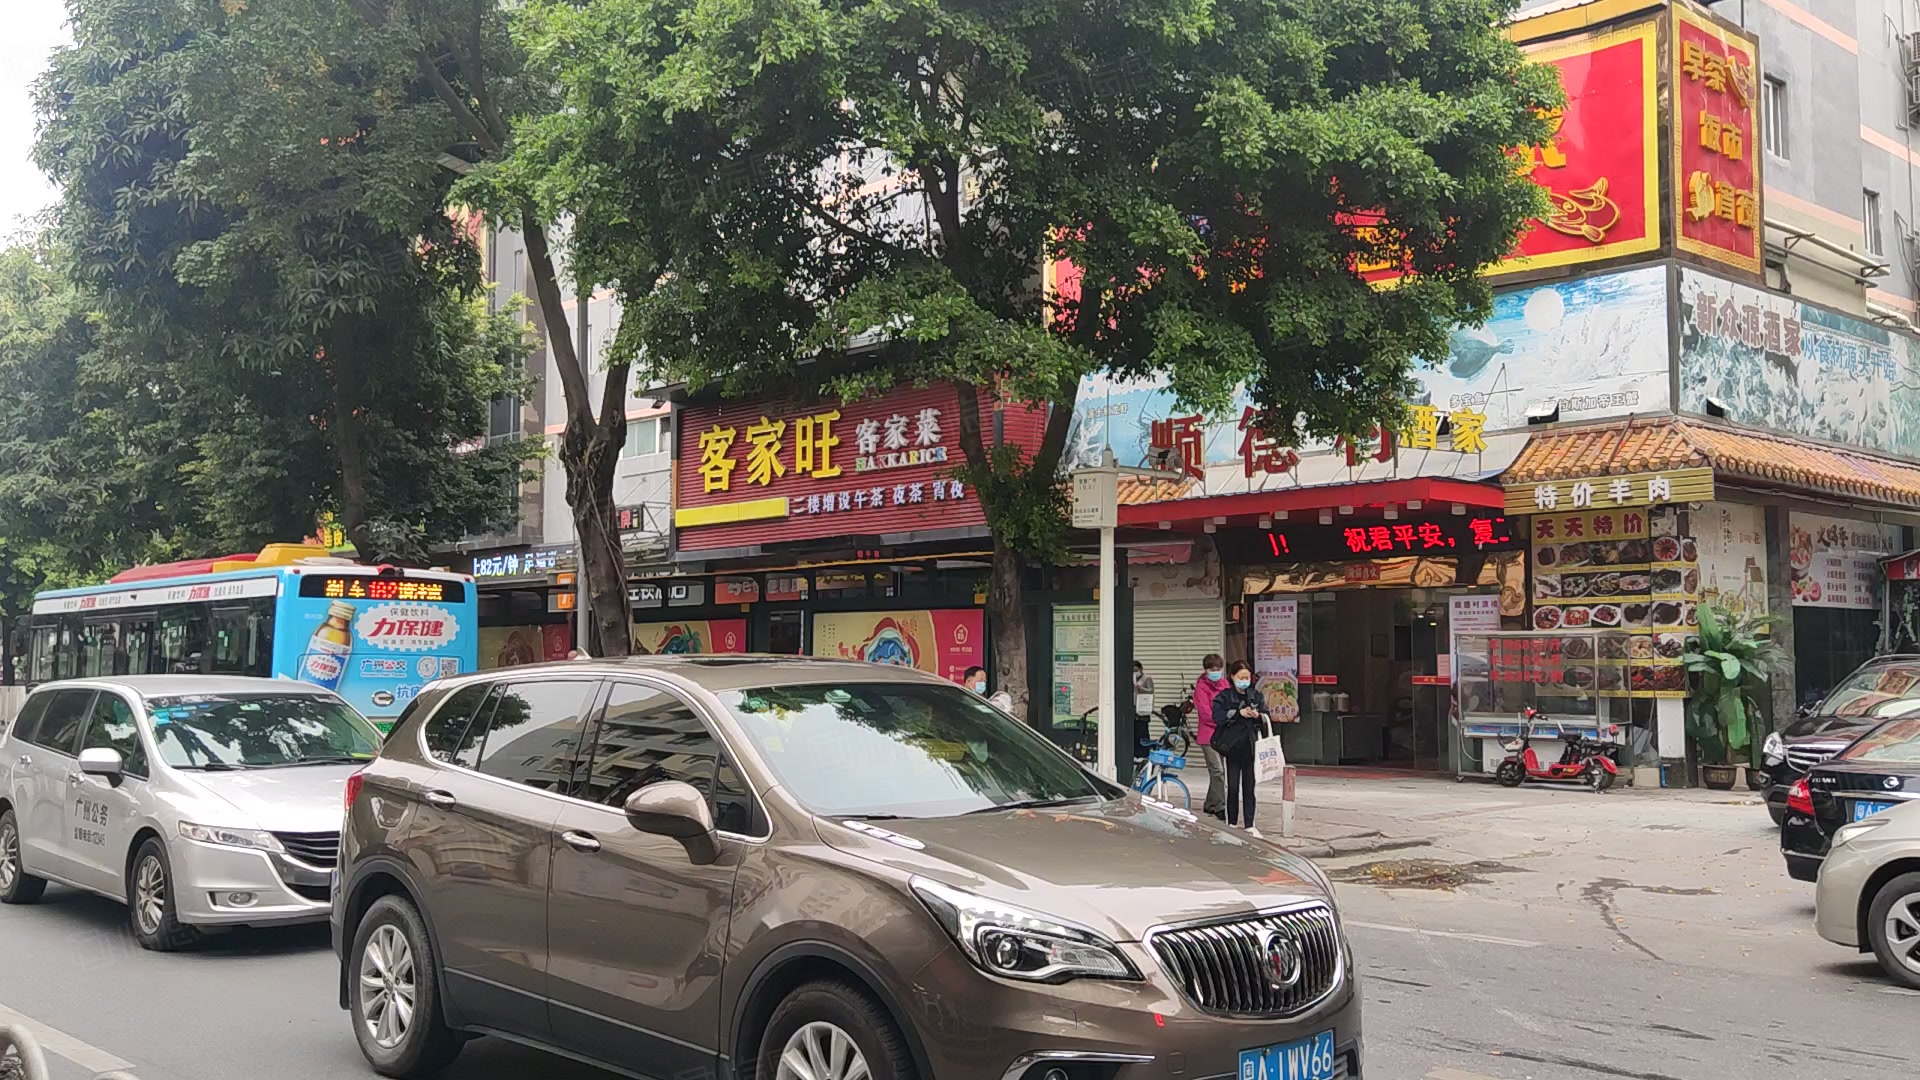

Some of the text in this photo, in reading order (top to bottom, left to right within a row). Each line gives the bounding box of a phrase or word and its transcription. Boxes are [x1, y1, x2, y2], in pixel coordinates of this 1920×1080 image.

[1683, 40, 1726, 93] 早茶
[1700, 110, 1742, 160] 饭市
[1715, 181, 1755, 230] 宵夜
[1697, 291, 1800, 357] 新众源酒家
[1802, 333, 1897, 382] 从食材源头开始
[855, 407, 942, 454] 客家菜
[698, 409, 841, 493] 客家旺
[855, 446, 947, 471] HAKKARICE
[1534, 475, 1672, 510] 特价羊肉
[1536, 513, 1644, 539] 天天特价
[368, 618, 443, 637] 力保健
[390, 607, 429, 616] 保健饮料
[361, 659, 406, 670] 广州公交
[75, 798, 108, 826] 广州公务
